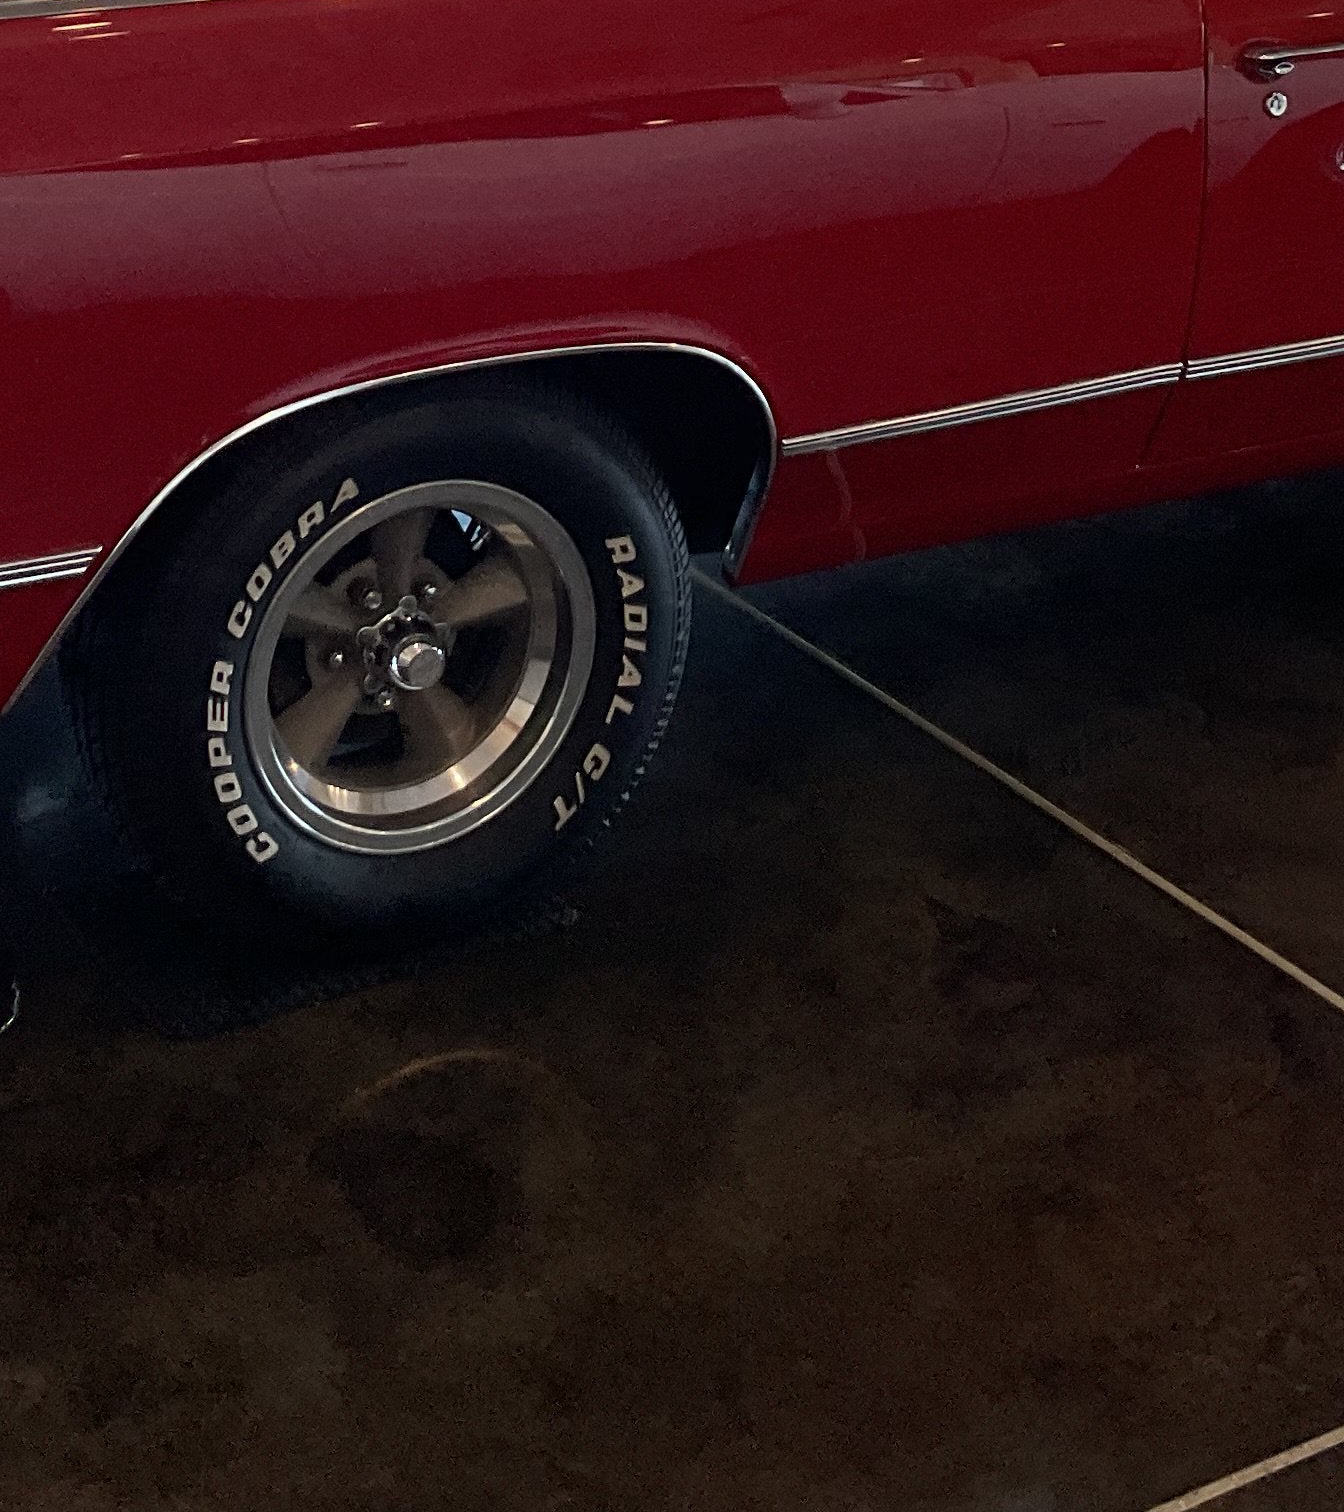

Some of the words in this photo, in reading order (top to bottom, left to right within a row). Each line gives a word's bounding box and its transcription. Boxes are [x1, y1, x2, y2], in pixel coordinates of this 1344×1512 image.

[226, 477, 360, 640] COBRA
[604, 533, 648, 725] RADIAL
[206, 660, 280, 864] COOPER
